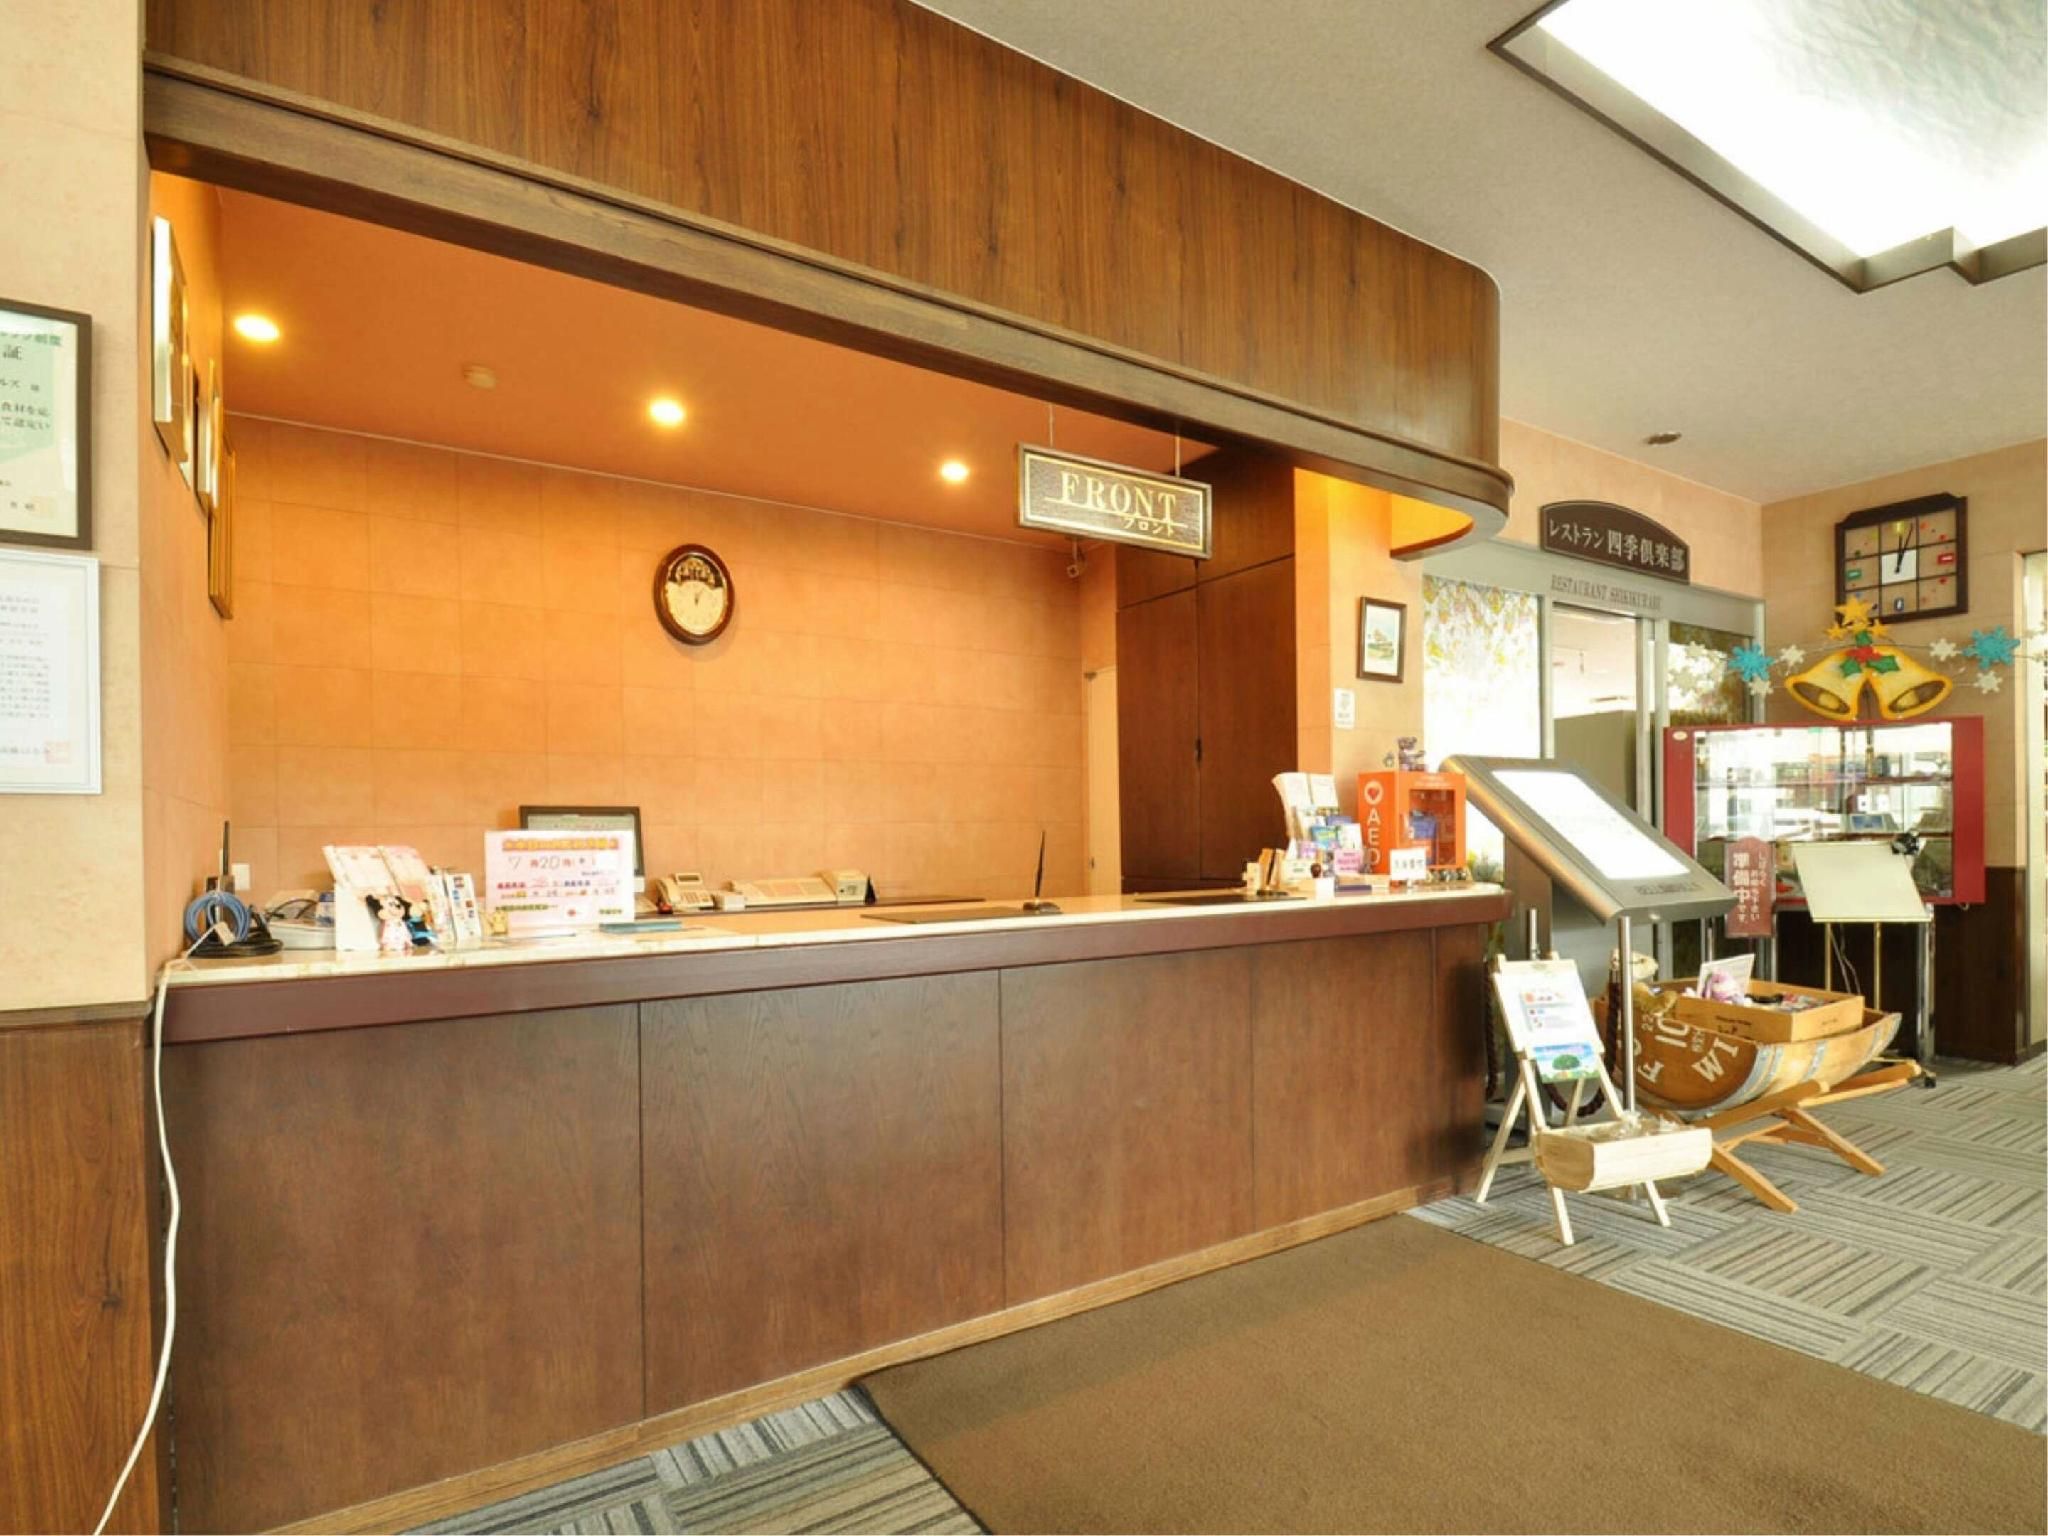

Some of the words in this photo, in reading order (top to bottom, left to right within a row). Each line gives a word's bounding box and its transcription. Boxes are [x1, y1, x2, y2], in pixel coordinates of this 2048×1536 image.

[1060, 471, 1177, 523] FRONT
[1124, 516, 1175, 538] フロント
[1549, 519, 1605, 549] レストラン
[1607, 529, 1686, 573] 四季倶楽部
